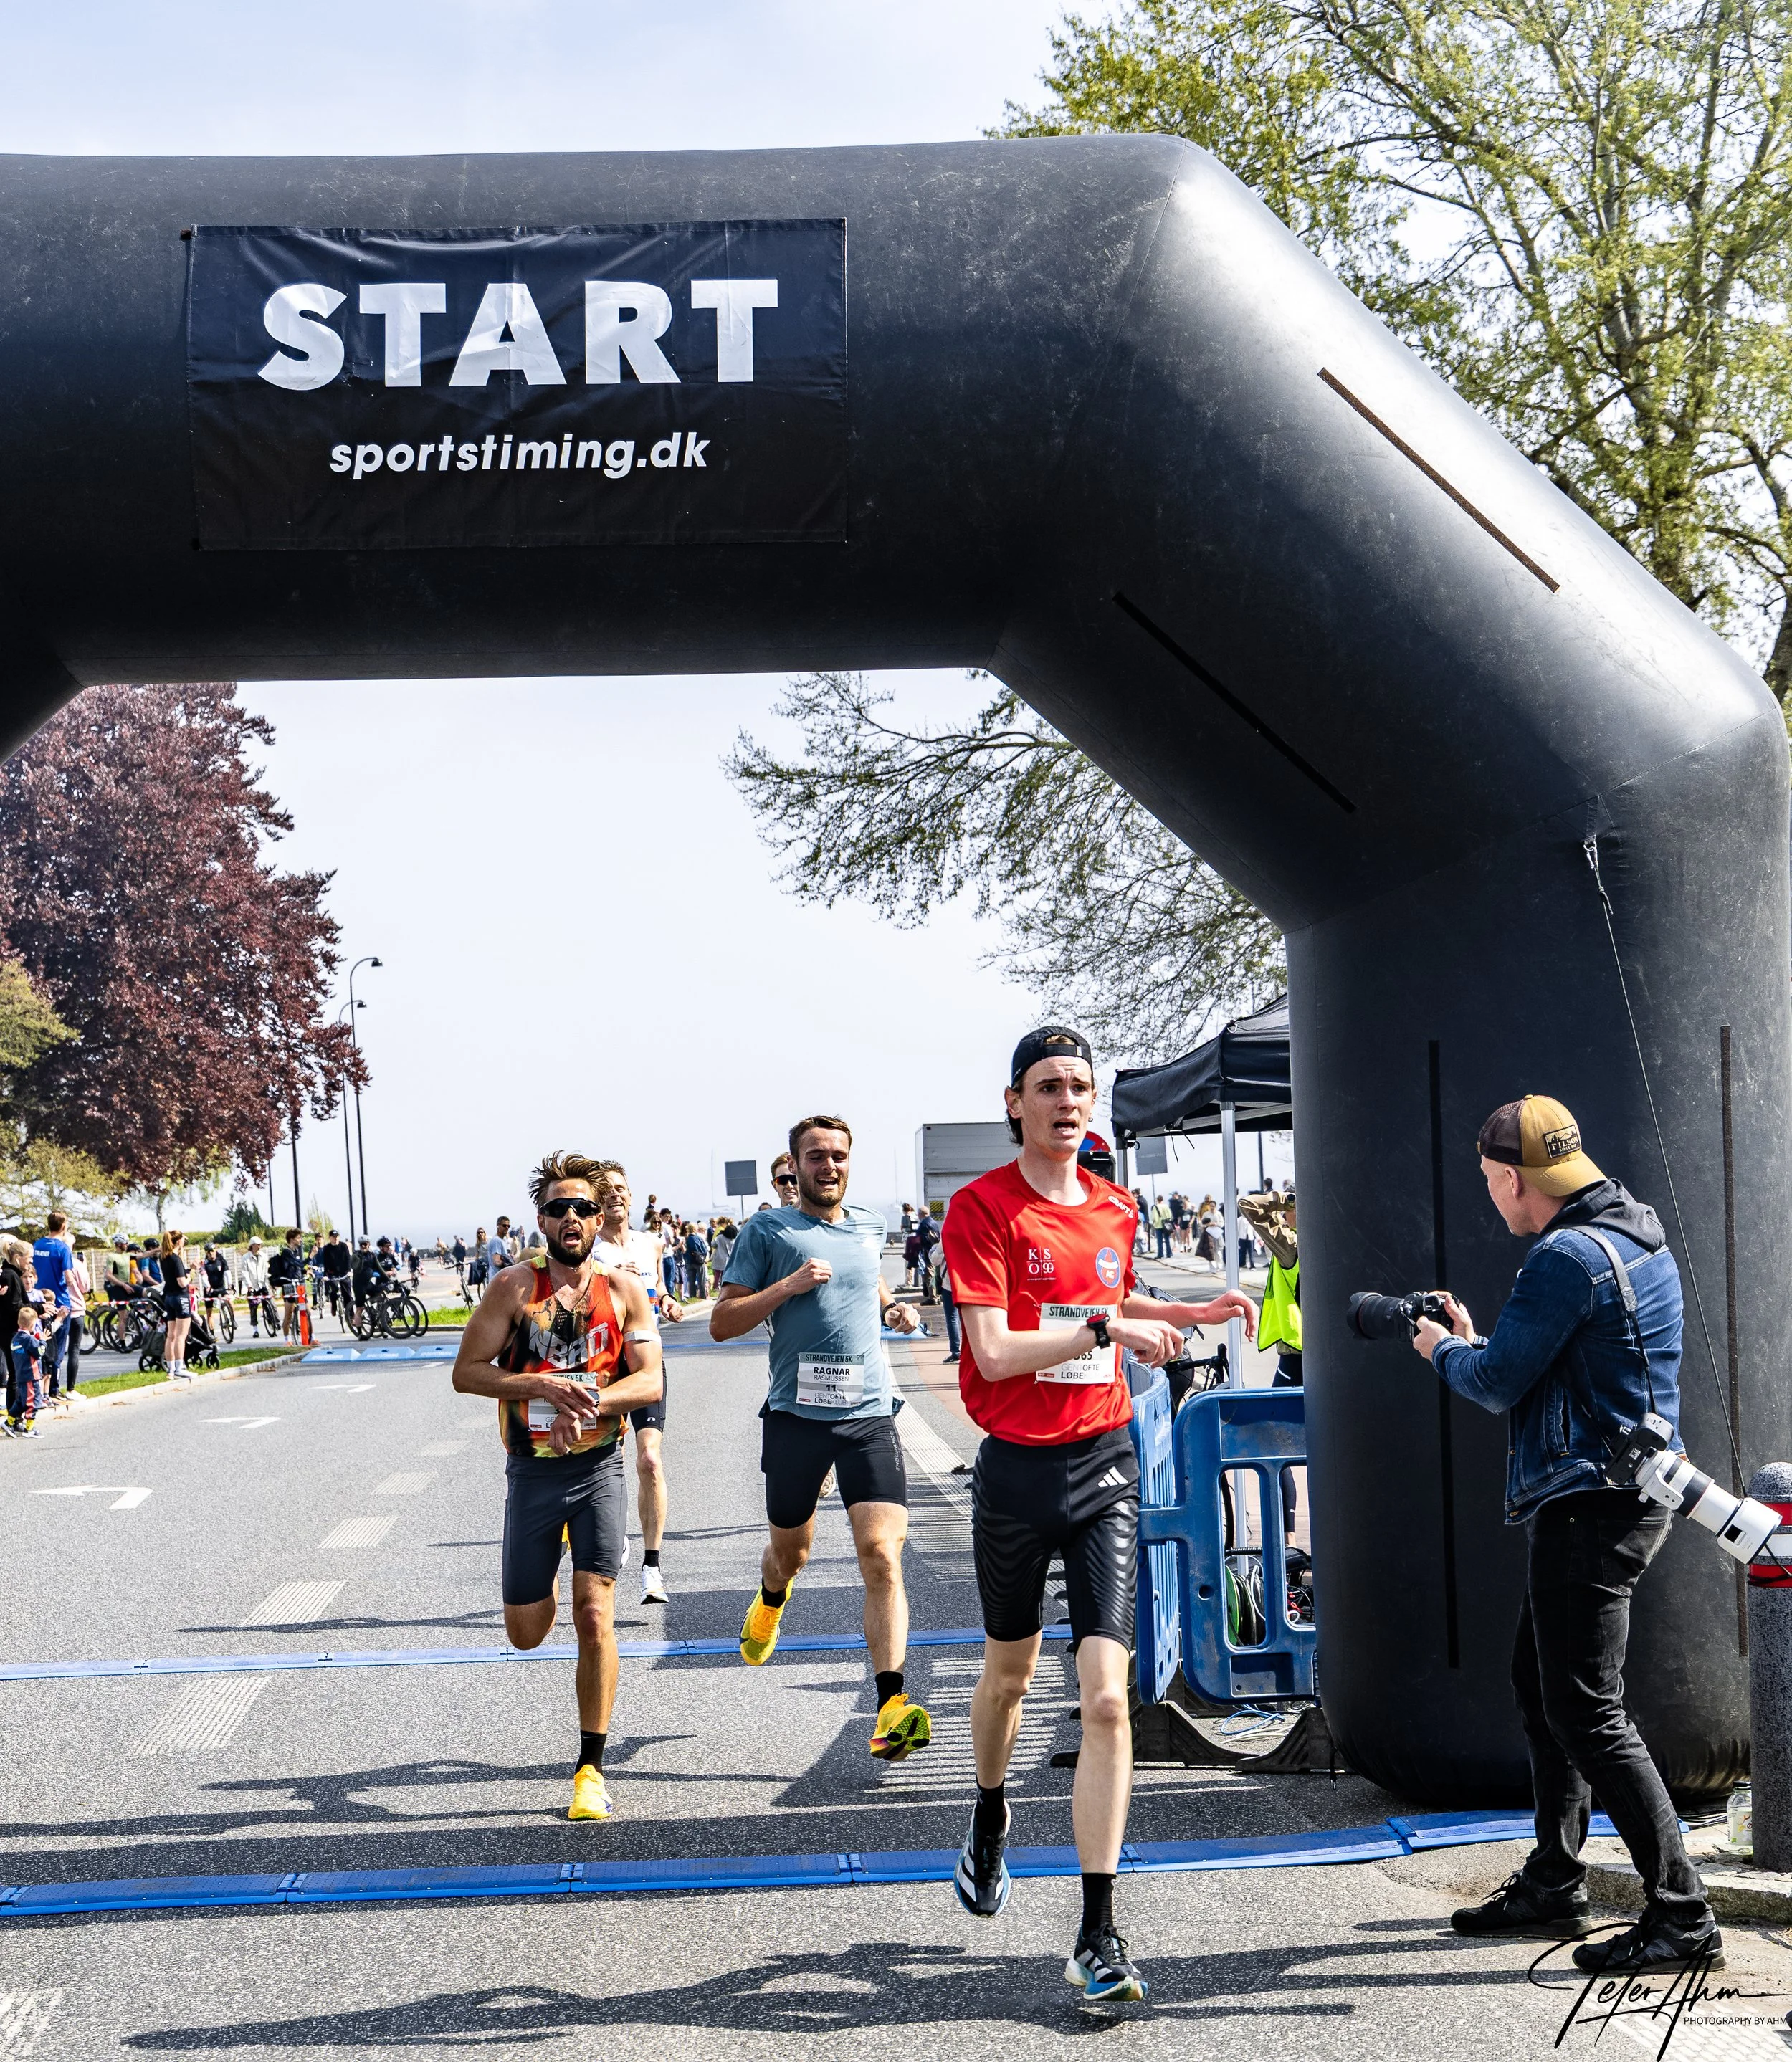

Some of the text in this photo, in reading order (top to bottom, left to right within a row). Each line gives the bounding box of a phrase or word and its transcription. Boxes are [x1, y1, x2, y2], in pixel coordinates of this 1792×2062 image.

[257, 278, 778, 391] START
[329, 432, 711, 480] sportstiming.dk
[1028, 1248, 1052, 1260] K S
[805, 1353, 844, 1363] STRANDVEJEN
[813, 1367, 851, 1375] RAGNAR
